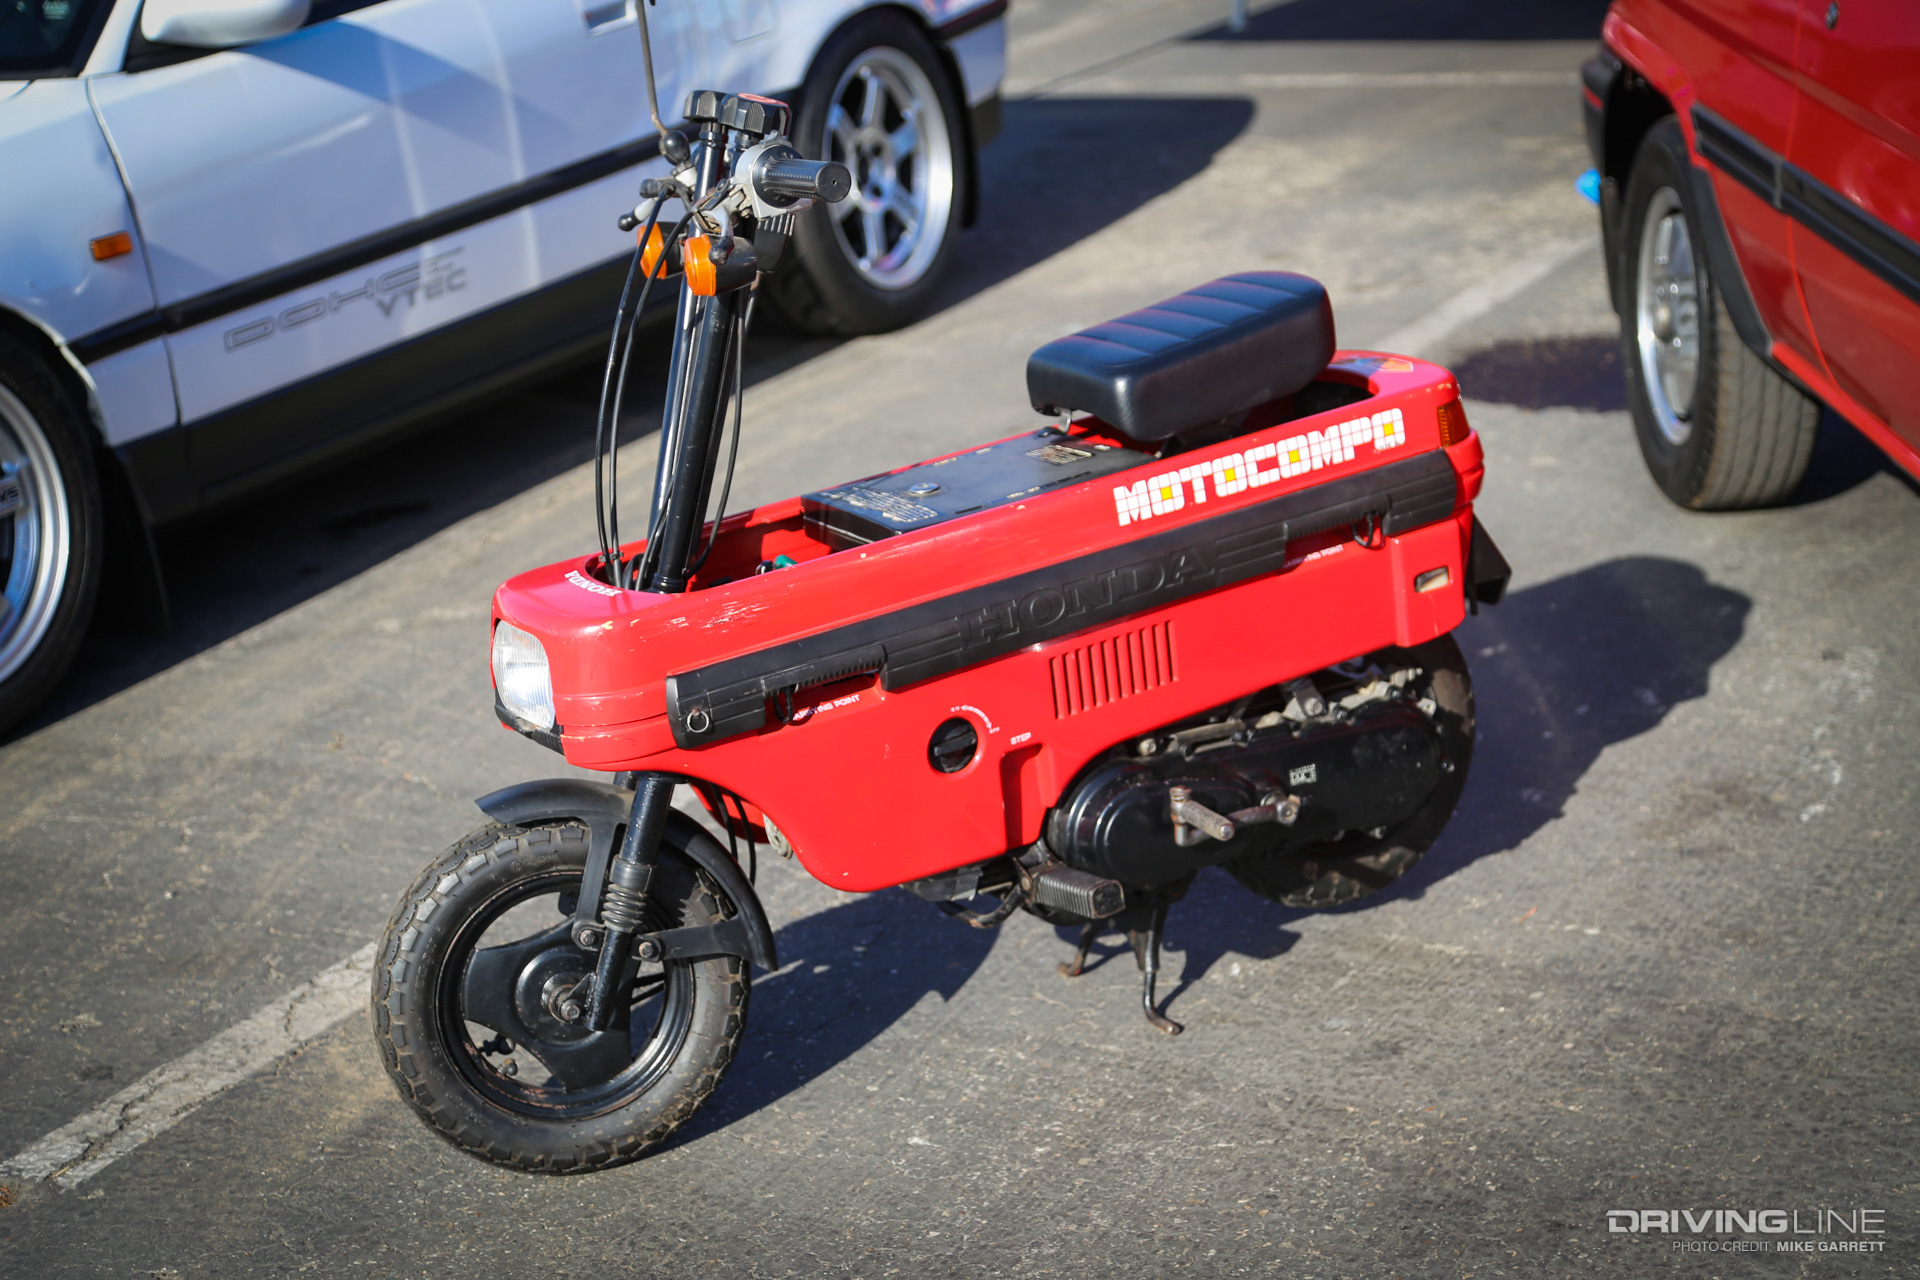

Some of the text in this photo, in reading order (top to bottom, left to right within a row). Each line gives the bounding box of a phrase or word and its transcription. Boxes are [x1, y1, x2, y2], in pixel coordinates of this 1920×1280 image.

[223, 246, 464, 354] DOHC
[376, 267, 468, 319] VTEC
[1113, 407, 1406, 527] MOTOCOMPO
[564, 569, 623, 597] HONDA
[961, 547, 1215, 648] HONDA
[792, 694, 860, 721] ARRYING POINT
[1010, 731, 1032, 746] STEP
